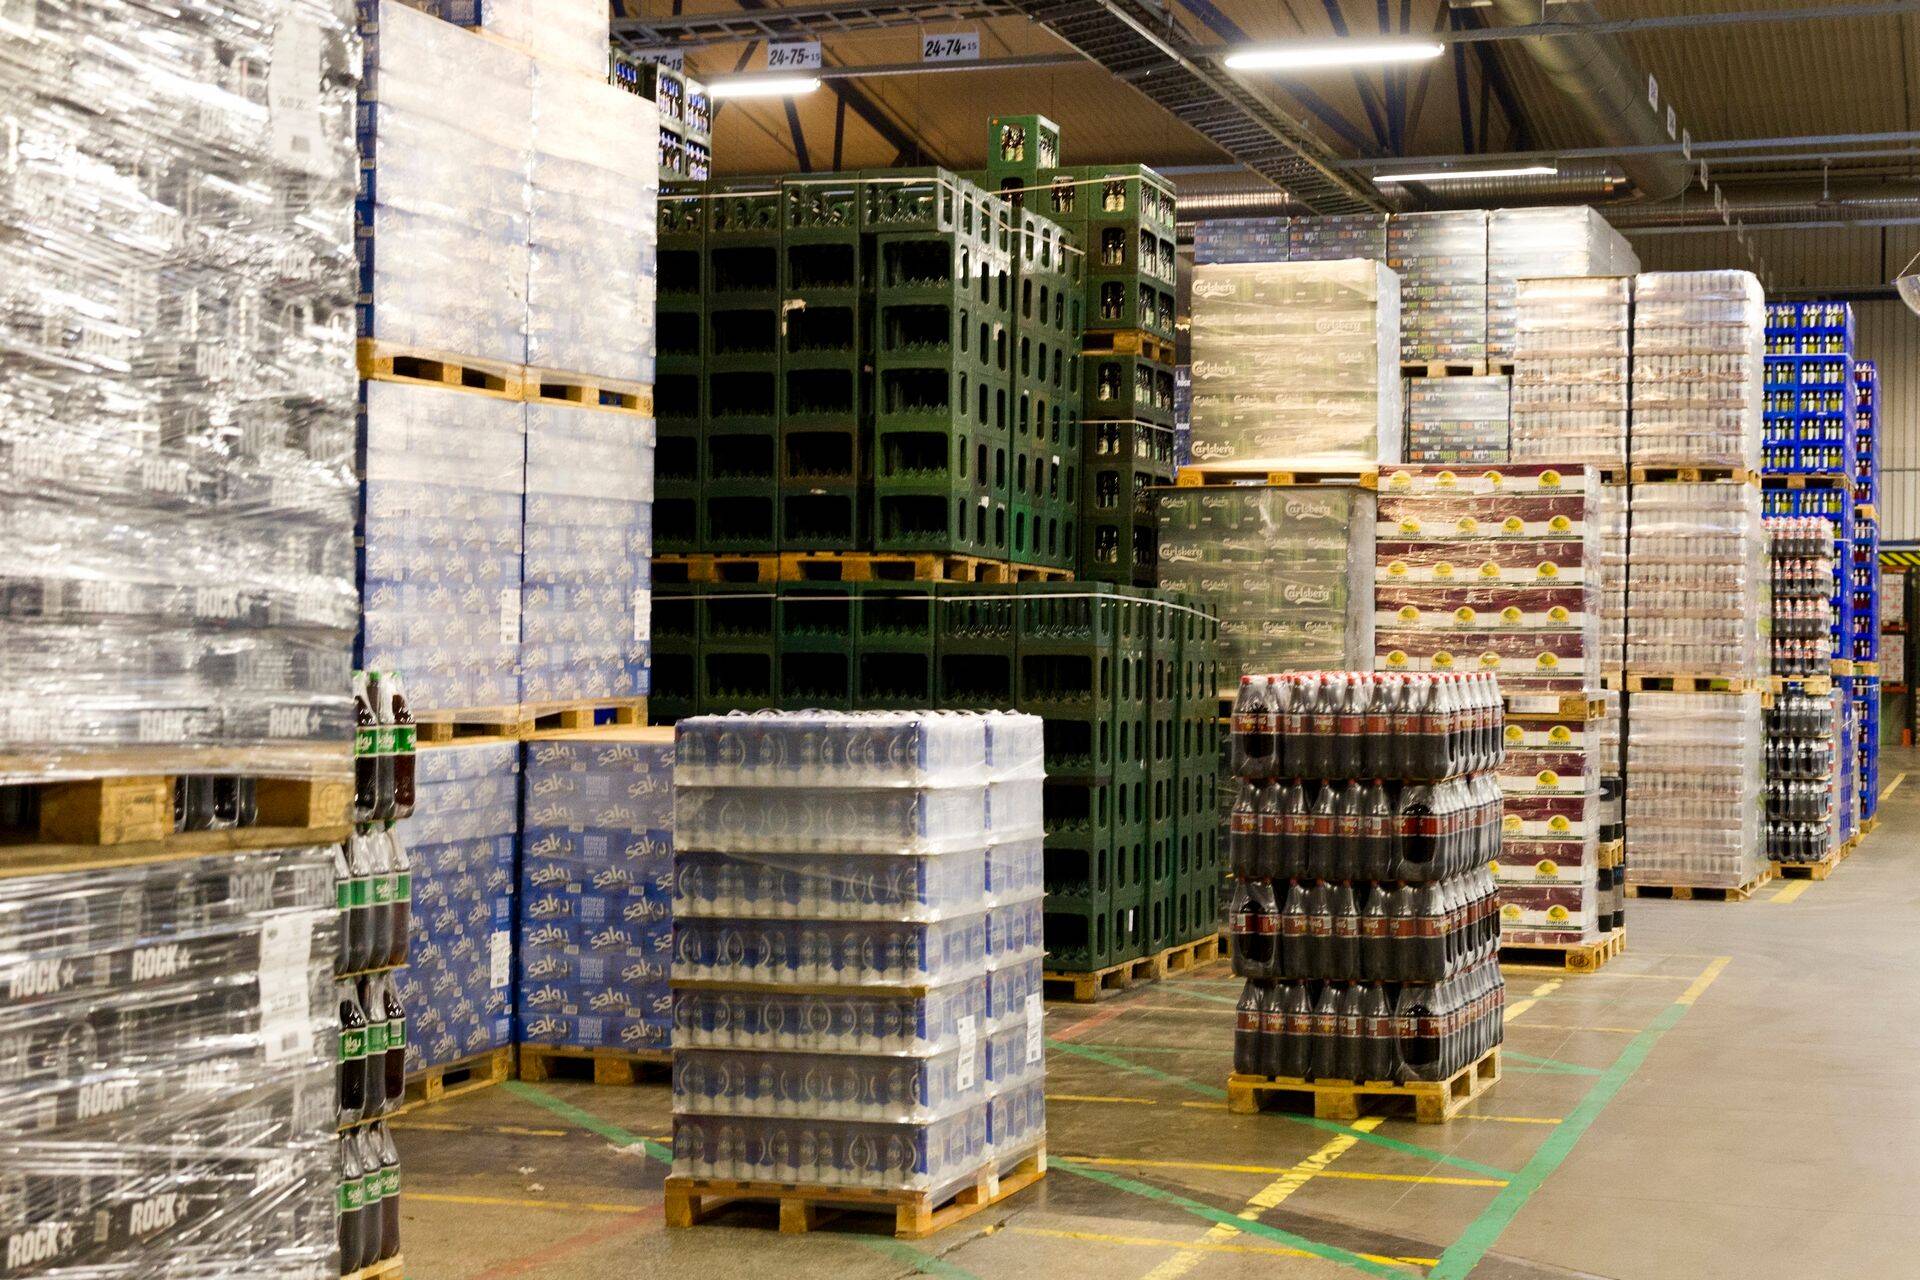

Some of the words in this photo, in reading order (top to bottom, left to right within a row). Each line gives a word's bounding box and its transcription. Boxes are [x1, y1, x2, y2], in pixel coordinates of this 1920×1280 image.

[1192, 279, 1236, 298] Carlsberg
[1316, 318, 1361, 335] Carlsberg
[1192, 361, 1236, 379] Carlsberg
[1316, 400, 1361, 417] Carlsberg
[1191, 441, 1235, 459] Carlsberg
[1285, 500, 1331, 520] Carlsberg
[1159, 543, 1203, 563] Carlsberg
[196, 587, 239, 617] ROCK
[1284, 585, 1330, 604] Carlsberg
[268, 707, 311, 737] ROCK
[660, 750, 675, 767] sa
[658, 811, 675, 828] sa
[656, 872, 673, 891] sa
[654, 934, 672, 951] sa
[132, 944, 178, 982] ROCK
[9, 957, 62, 1000] ROCK
[653, 995, 672, 1012] sa
[78, 1082, 125, 1119] ROCK
[130, 1193, 177, 1235] ROCK
[7, 1222, 60, 1269] ROCK
